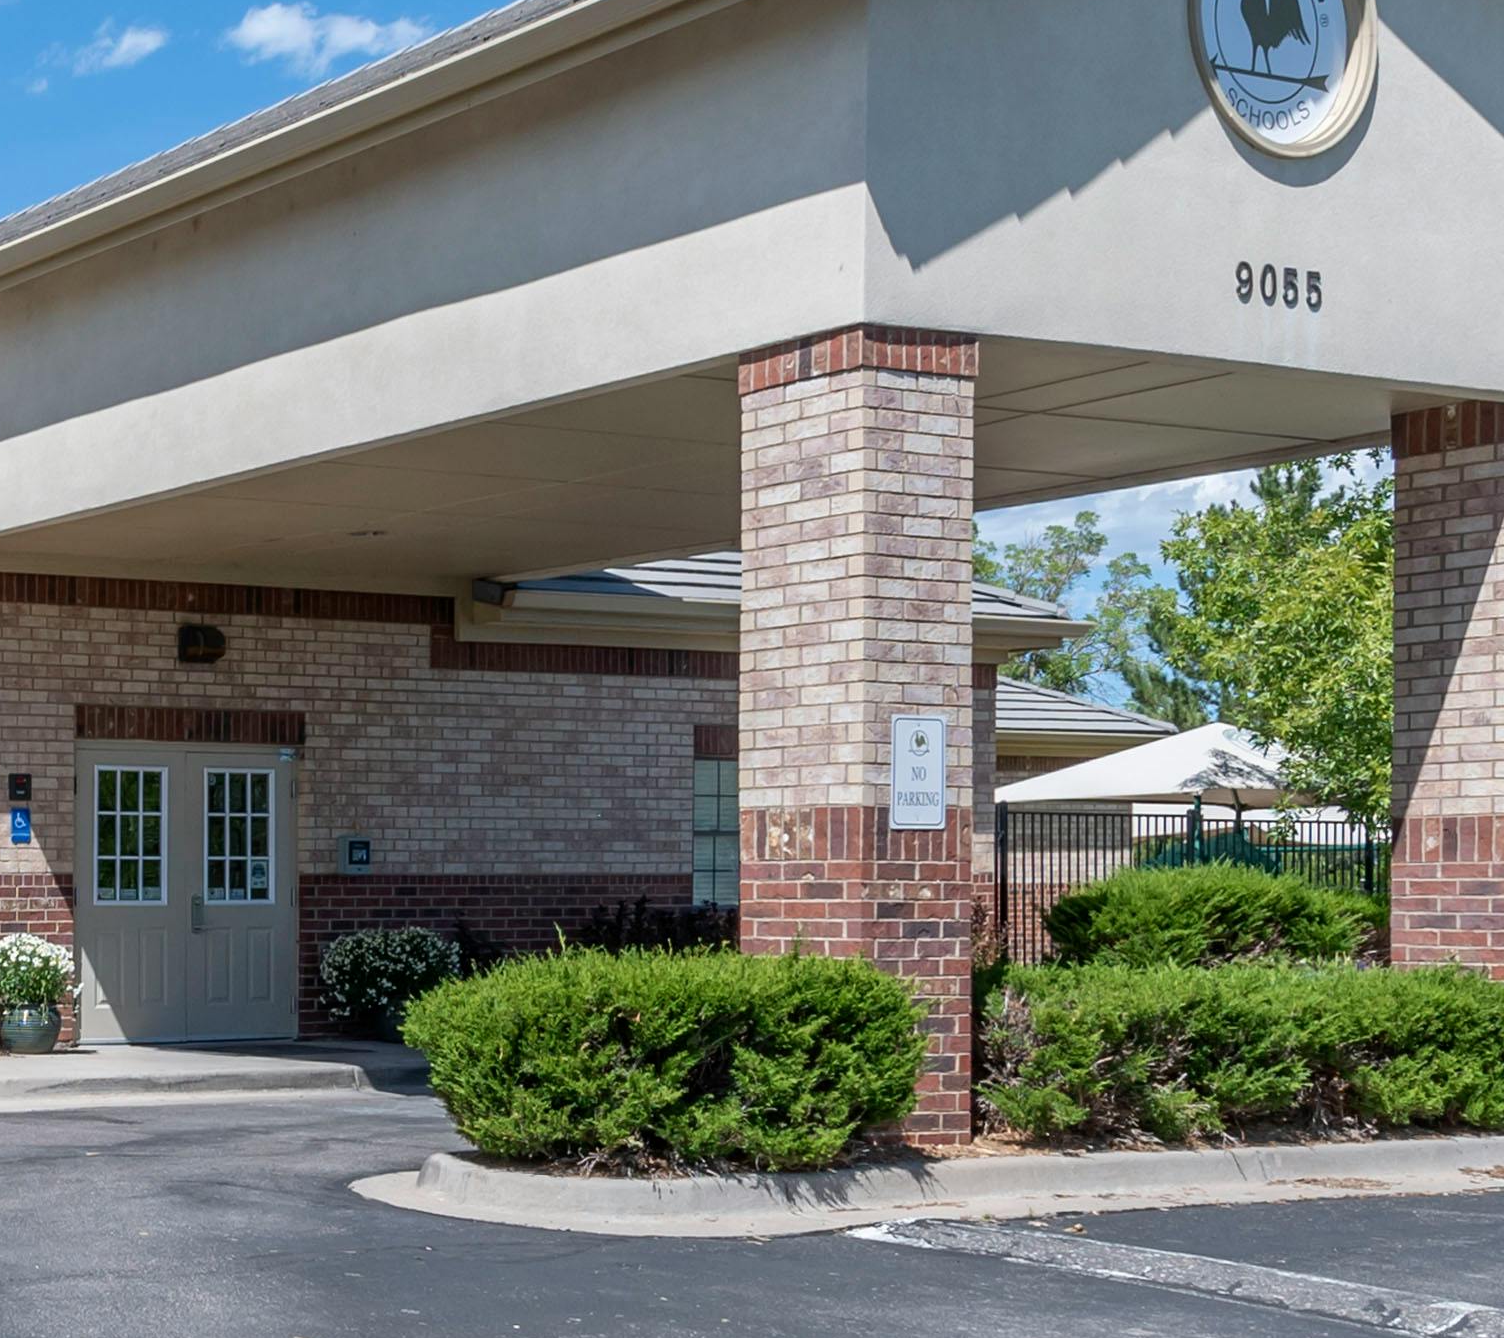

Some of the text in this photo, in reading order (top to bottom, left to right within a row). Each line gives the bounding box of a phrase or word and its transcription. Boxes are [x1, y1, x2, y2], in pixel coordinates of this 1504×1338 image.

[1226, 87, 1311, 131] SCHOOLS
[1235, 260, 1323, 314] 9055
[911, 765, 927, 782] NO
[897, 791, 940, 807] PARKING
